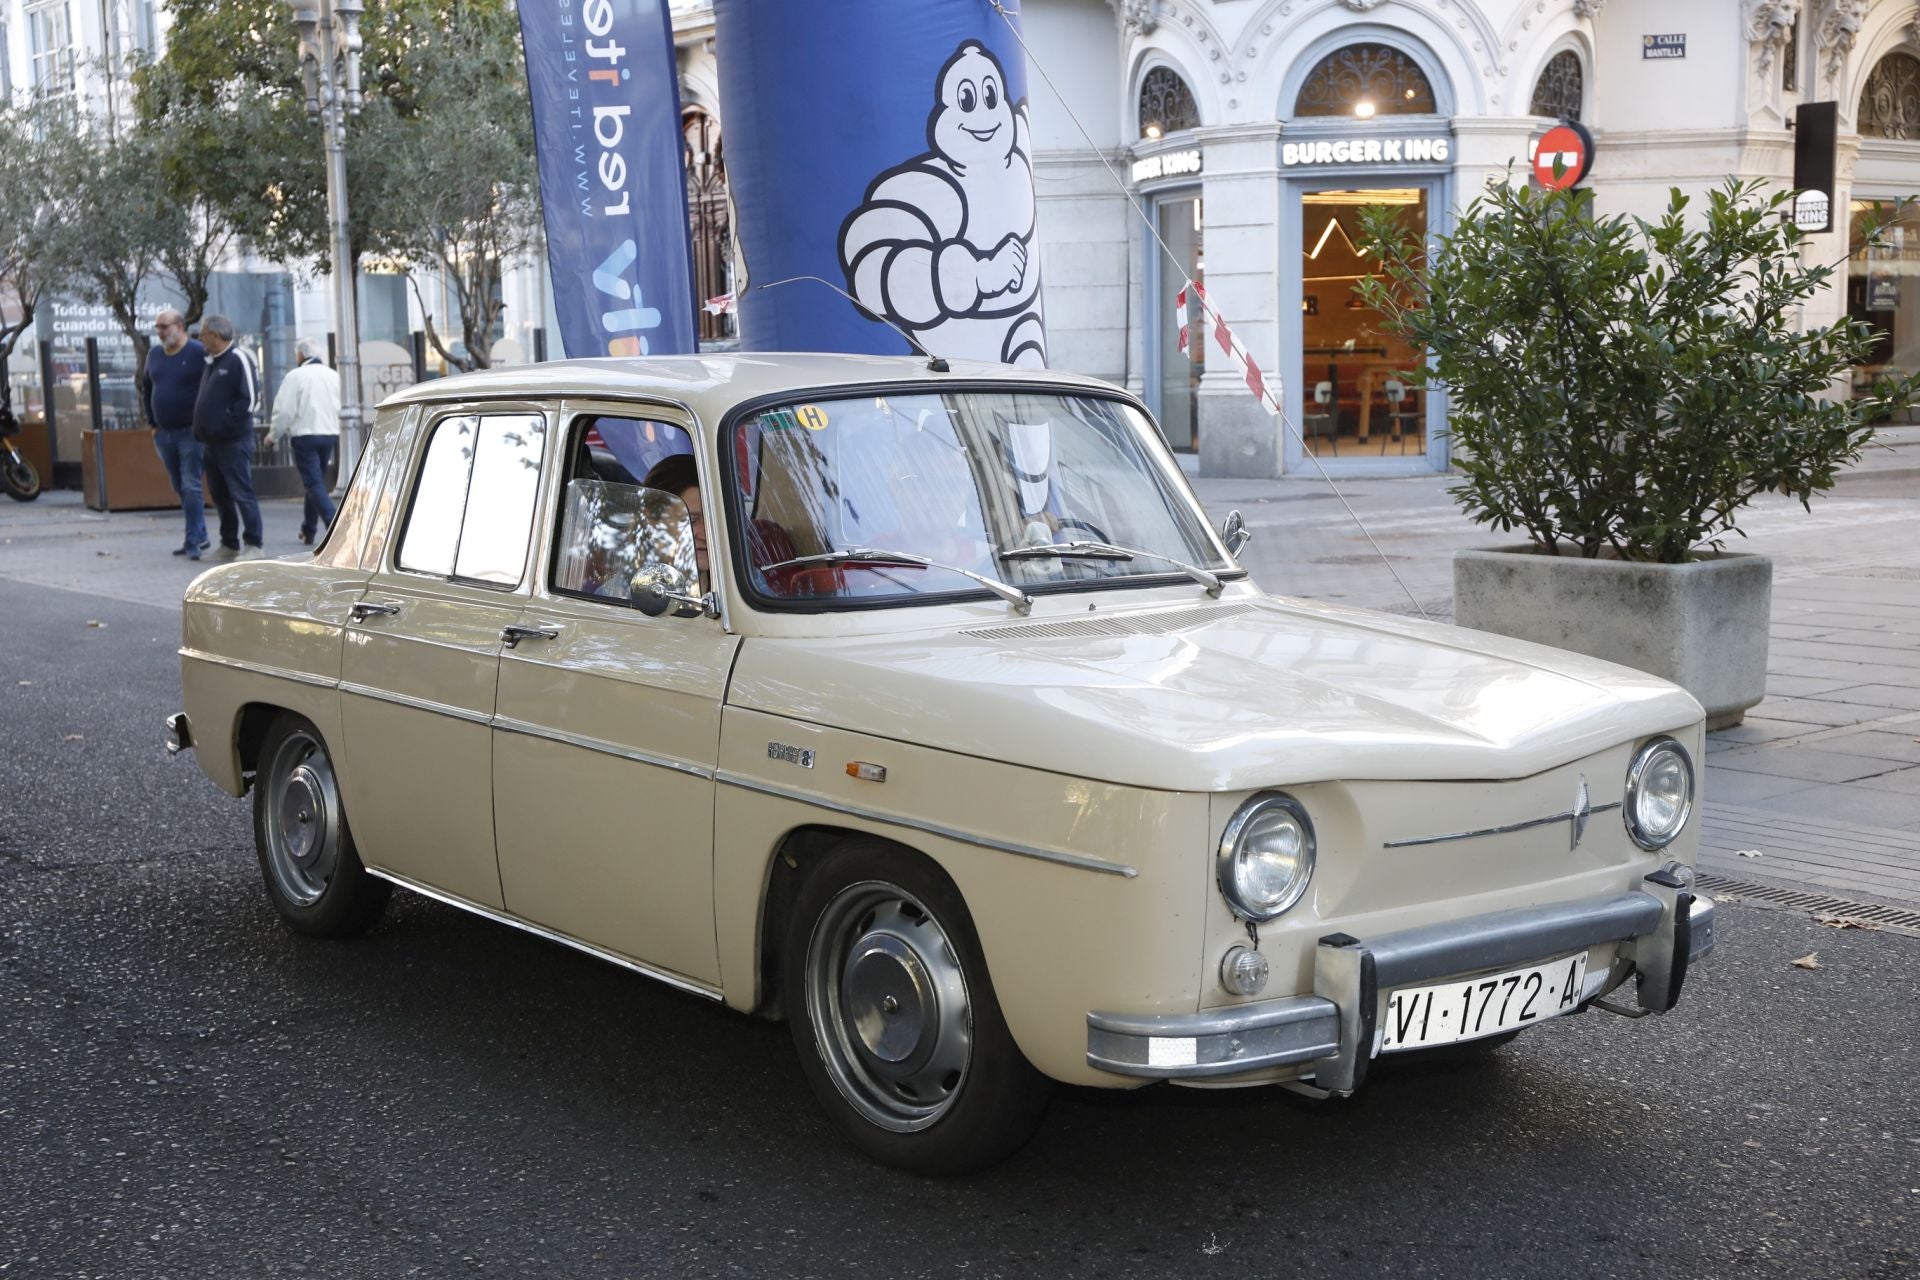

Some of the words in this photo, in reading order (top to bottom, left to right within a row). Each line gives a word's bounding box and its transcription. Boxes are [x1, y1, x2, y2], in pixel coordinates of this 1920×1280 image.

[1657, 35, 1685, 45] CALLE
[1646, 48, 1684, 58] MANTILLA
[1283, 139, 1382, 165] BURGER
[1162, 150, 1201, 175] KING
[1795, 202, 1829, 212] BURGER
[1795, 210, 1828, 223] KING
[51, 303, 88, 317] Todo
[53, 317, 106, 332] cuando
[54, 334, 68, 347] el
[803, 407, 823, 428] H
